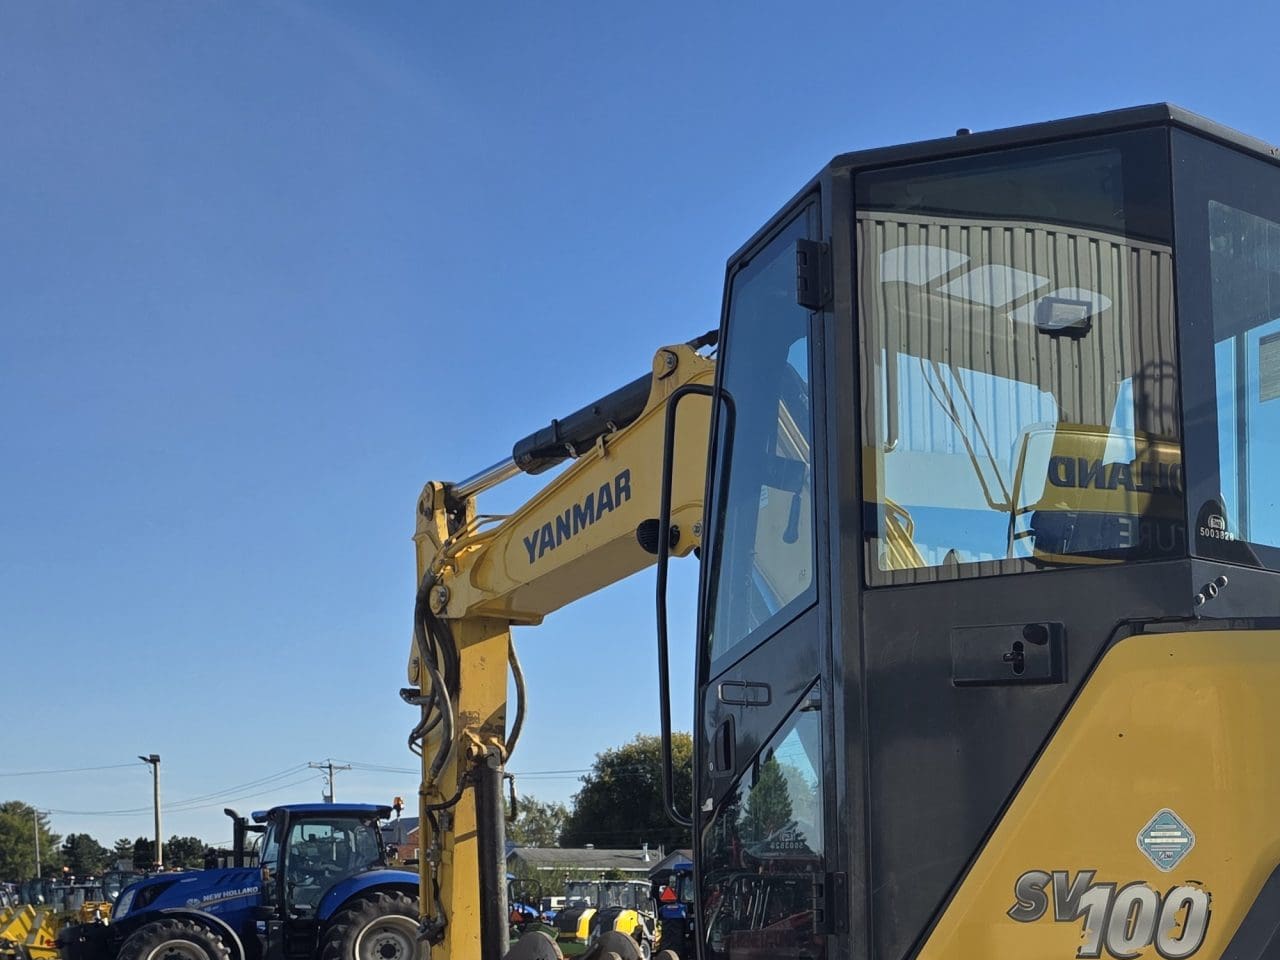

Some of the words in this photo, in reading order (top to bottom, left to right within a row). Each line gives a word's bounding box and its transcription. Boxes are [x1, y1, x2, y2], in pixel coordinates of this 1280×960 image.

[523, 468, 631, 564] YANMAR
[203, 893, 221, 901] NEW
[222, 886, 259, 898] HOLLAND
